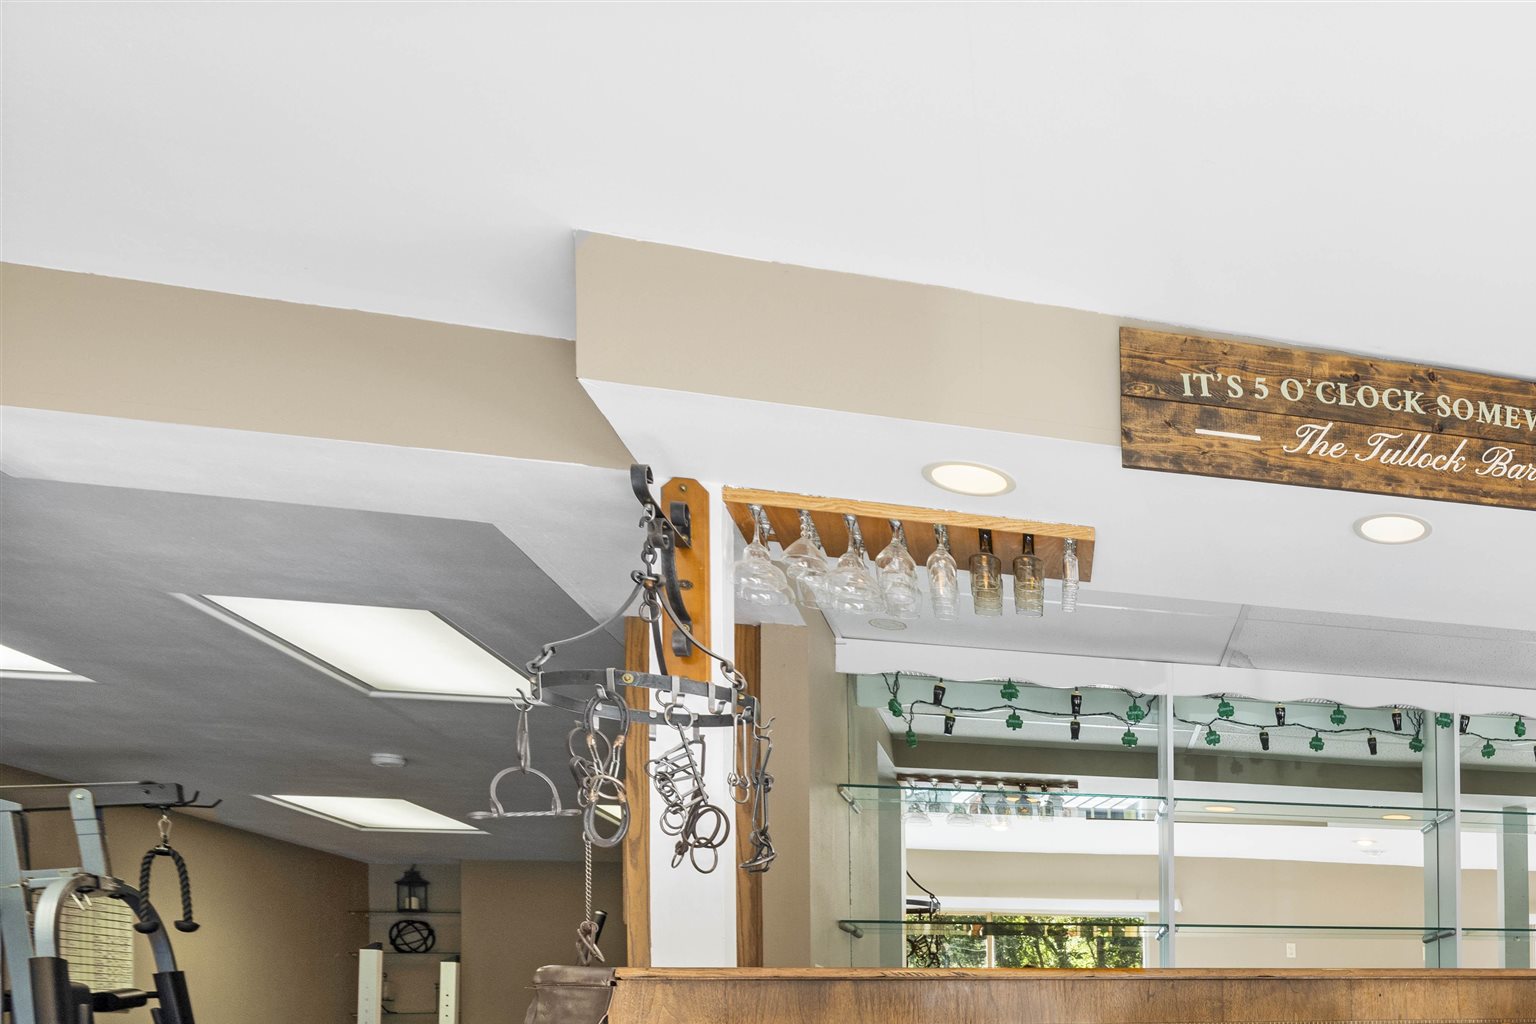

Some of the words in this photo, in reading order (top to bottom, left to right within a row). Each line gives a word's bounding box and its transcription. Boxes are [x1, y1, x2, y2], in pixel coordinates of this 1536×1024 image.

[1180, 372, 1244, 399] IT'S
[1254, 376, 1270, 400] 5
[1280, 378, 1427, 416] O'CLOCK
[1282, 420, 1348, 459] The
[1354, 432, 1468, 474] Tullock
